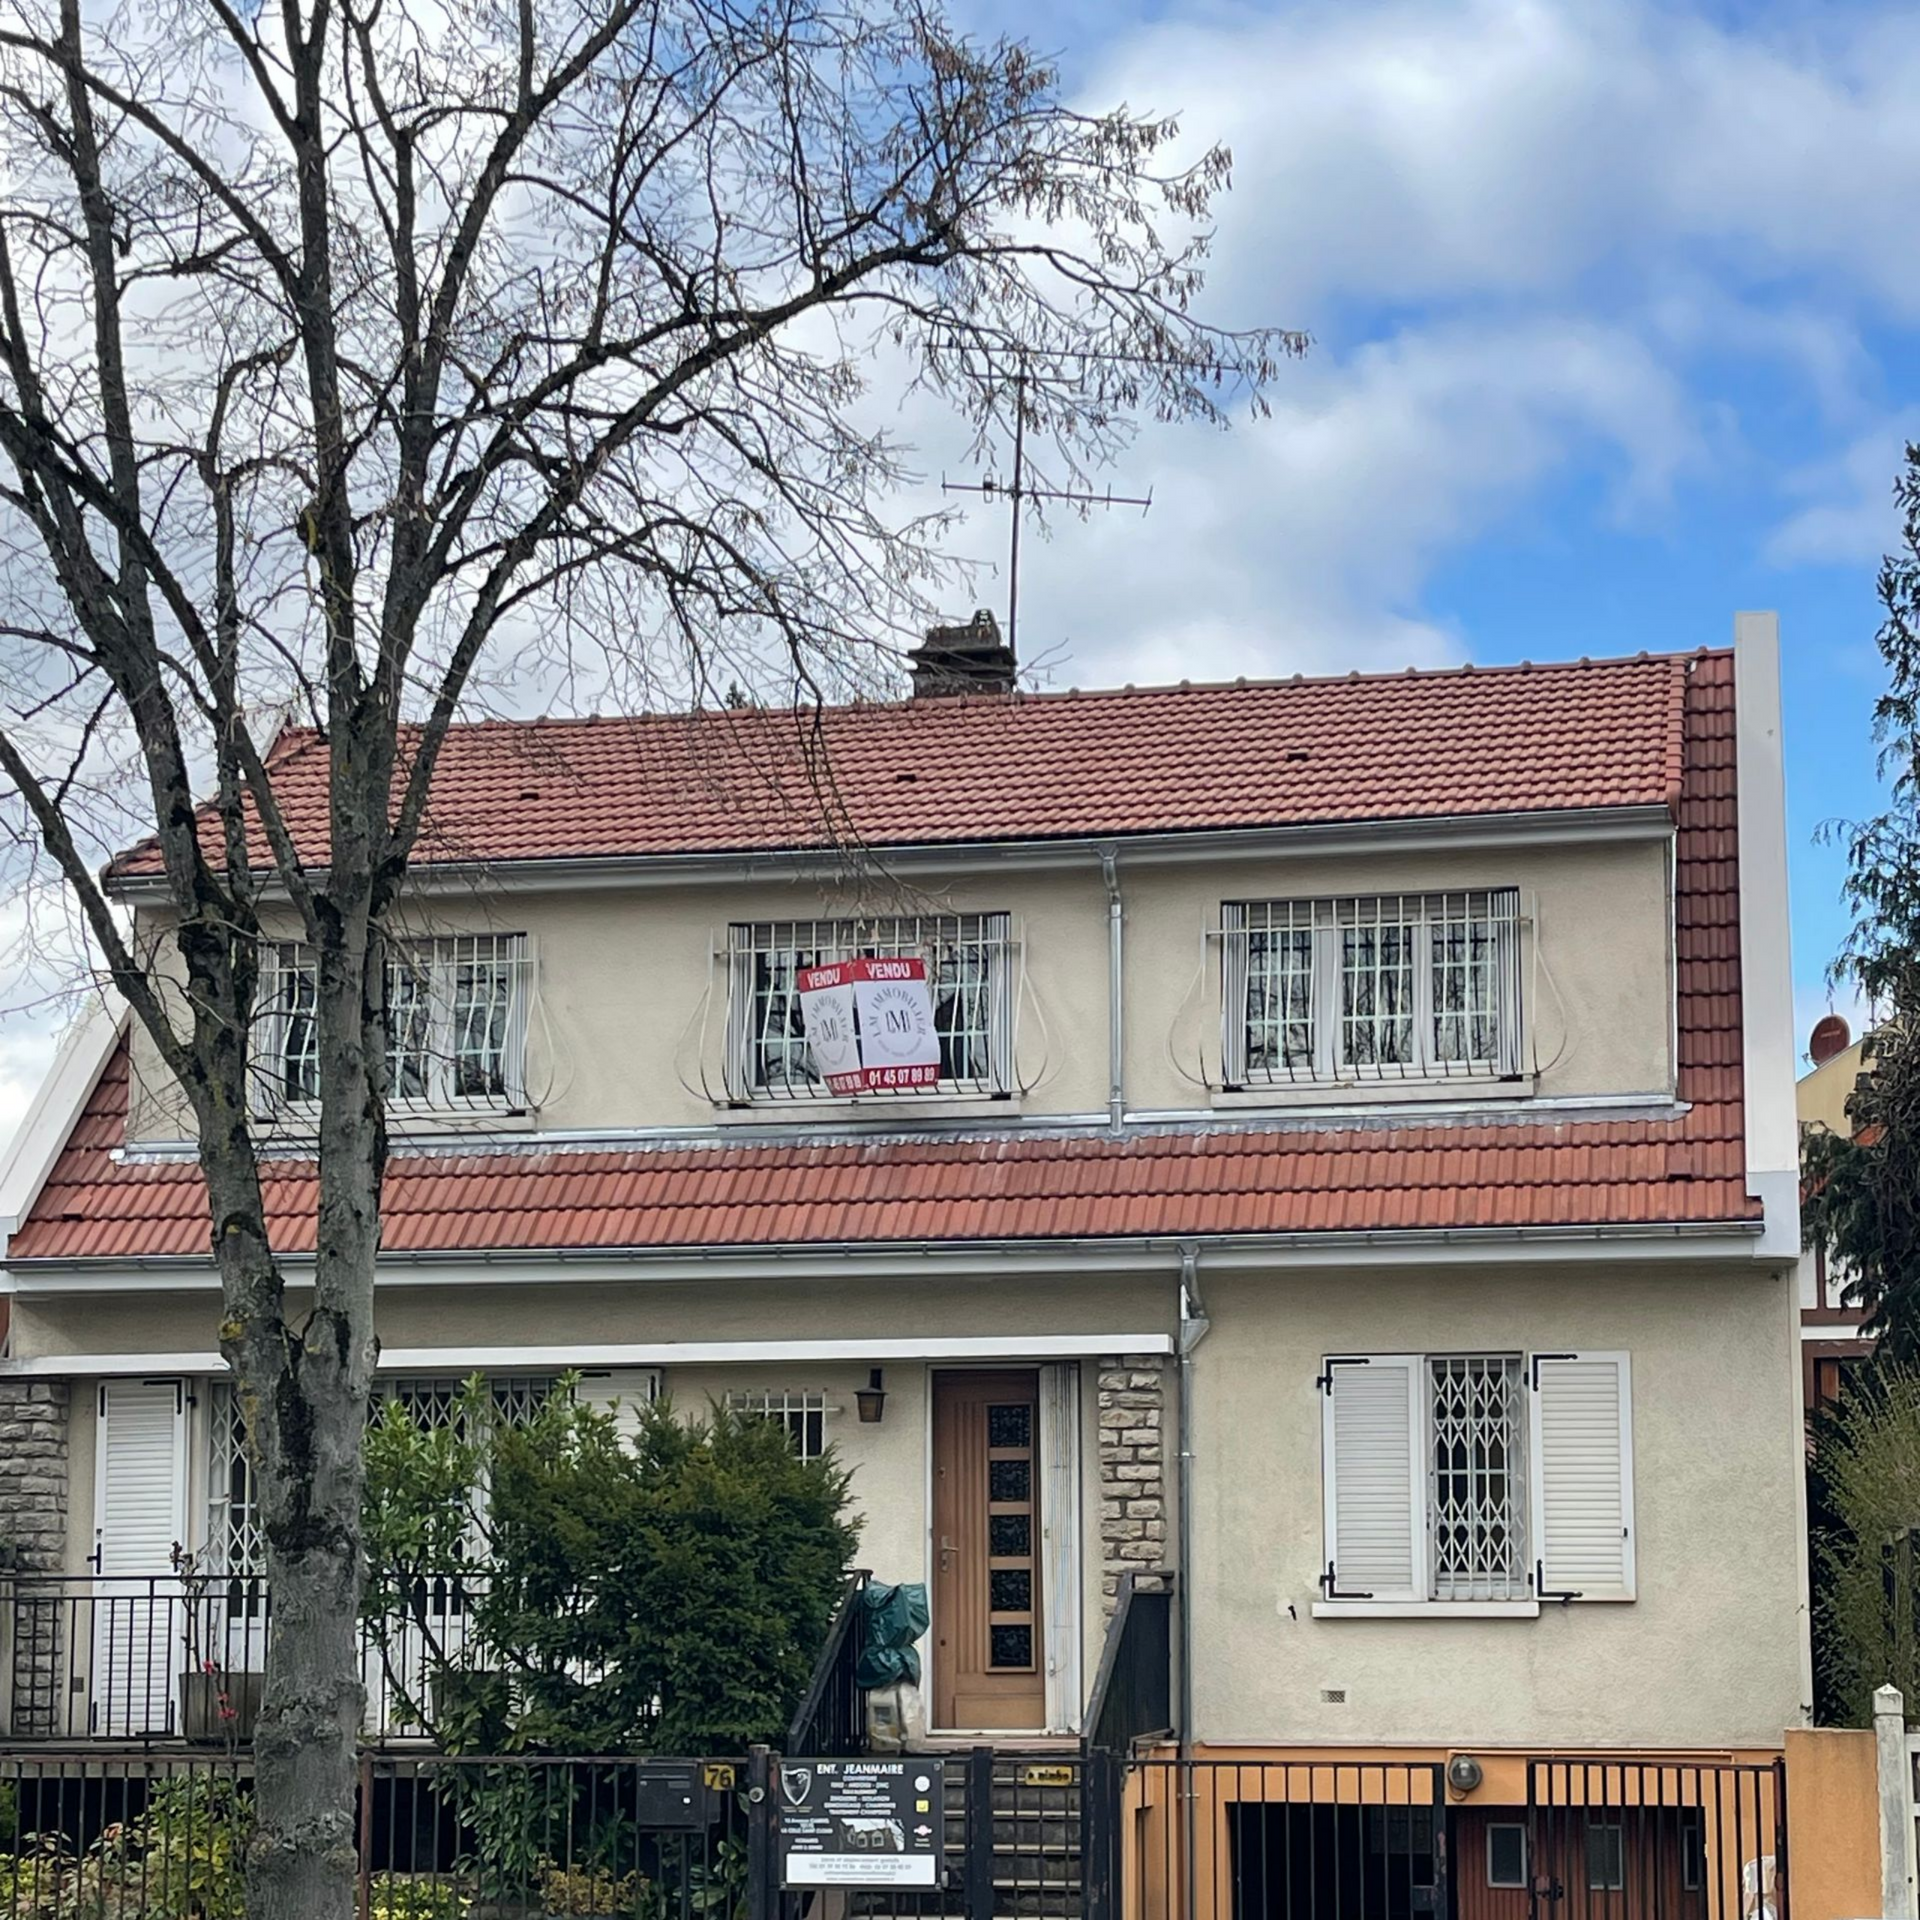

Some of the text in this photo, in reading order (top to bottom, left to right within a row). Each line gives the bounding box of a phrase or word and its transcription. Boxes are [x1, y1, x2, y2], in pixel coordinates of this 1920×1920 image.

[807, 968, 841, 989] VENDU
[865, 962, 911, 979] VENDU
[871, 986, 926, 1035] IMMOBILIER
[869, 1070, 881, 1086] 01
[884, 1069, 896, 1084] 45
[897, 1068, 909, 1084] 07
[707, 1767, 732, 1788] 76
[816, 1763, 904, 1775] ENT. JEANMAIRE
